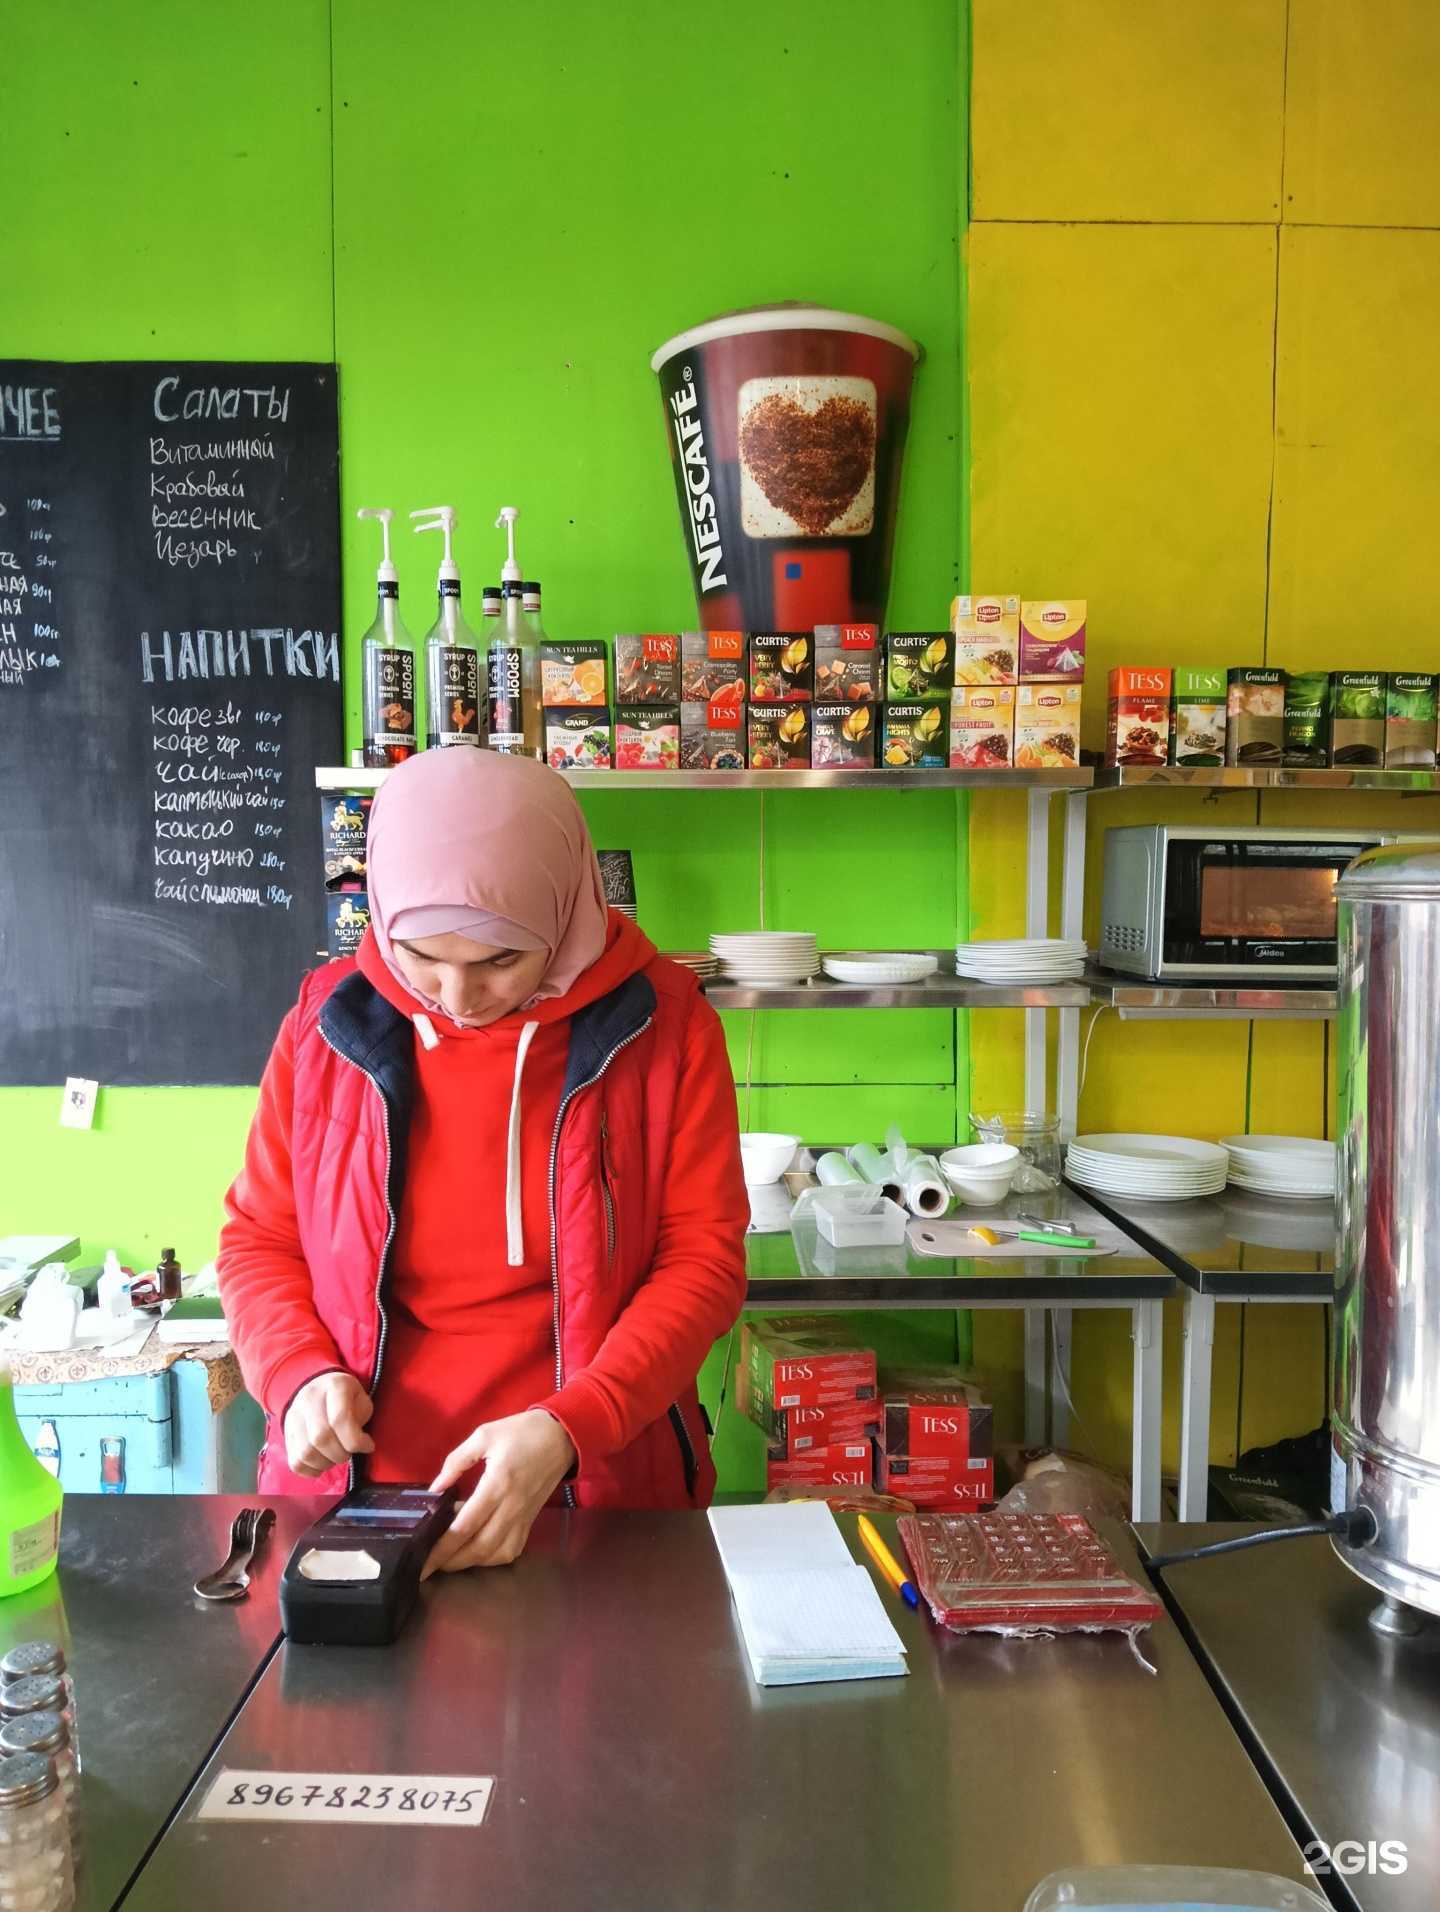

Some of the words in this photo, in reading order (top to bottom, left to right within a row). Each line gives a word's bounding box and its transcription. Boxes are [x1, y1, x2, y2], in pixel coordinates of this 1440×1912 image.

[154, 376, 290, 422] Салаты
[150, 432, 276, 465] Витаминный
[151, 468, 245, 502] Крабовый
[670, 382, 728, 593] NESCAFÉ
[156, 531, 237, 568] Цезарь
[713, 636, 738, 649] TESS
[755, 636, 790, 646] CURTIS
[845, 629, 871, 641] TESS
[893, 637, 928, 646] CURTIS
[141, 628, 340, 682] НАПИТКИ
[402, 655, 412, 699] SPOOM
[507, 653, 520, 697] SPOOM
[1128, 672, 1164, 690] TESS
[1188, 673, 1221, 689] TESS
[1245, 671, 1279, 682] Greenfield
[1343, 674, 1379, 685] Greenfield
[1395, 676, 1431, 686] Greenfield
[712, 707, 736, 719] TESS
[753, 708, 787, 718] CURTIS
[817, 707, 850, 716] CURTIS
[888, 707, 922, 716] CURTIS
[1285, 707, 1321, 718] Greenfield
[1256, 946, 1285, 958] Midea
[781, 1364, 814, 1382] TESS
[795, 1407, 825, 1425] TESS
[921, 1416, 958, 1434] TESS
[953, 1483, 987, 1499] TESS
